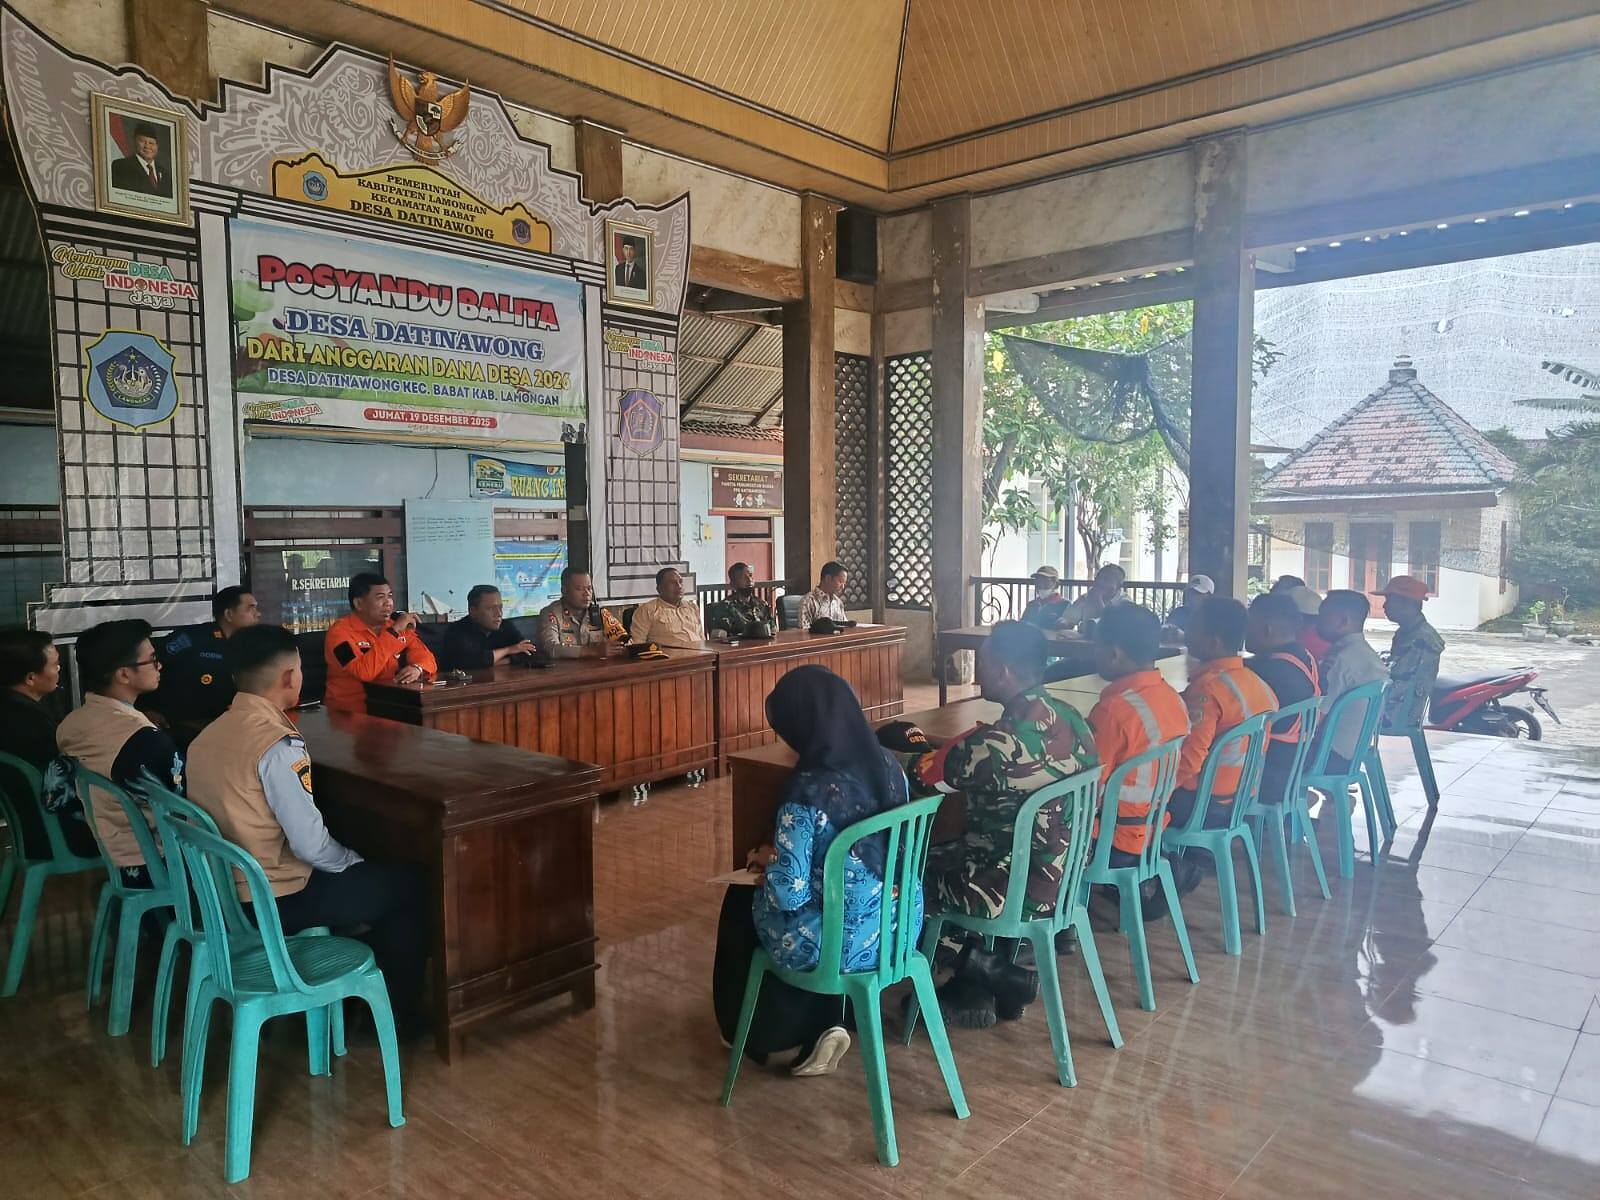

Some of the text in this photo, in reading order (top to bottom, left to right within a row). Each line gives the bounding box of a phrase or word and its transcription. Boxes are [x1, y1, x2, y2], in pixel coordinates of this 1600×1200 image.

[357, 178, 487, 215] KABUPATEN LAMONGAN
[386, 174, 461, 198] PEMERINTAH
[371, 192, 476, 222] KECAMATAN BABAT
[350, 200, 494, 240] DESA DATINAWONG
[53, 245, 173, 281] Membangun DESA
[105, 273, 196, 298] INDONESIA
[257, 254, 560, 332] POSYANDU BALITA
[130, 290, 174, 308] Jaya
[285, 308, 544, 361] DESA DATINAWONG
[247, 337, 571, 390] DARI ANGGARAN DANA DESA 2026
[629, 348, 674, 363] INDONESIA
[268, 368, 559, 406] DESA DATINAWONG KEC. BABAT KAB. LAMONGAN
[272, 405, 320, 420] INDONESIA
[372, 409, 491, 427] JUMAT, 19 DESEMBER 2025
[511, 475, 549, 498] RUANG
[727, 473, 769, 483] SEKRETARIAT
[291, 576, 351, 591] R.SEKRETARIAT
